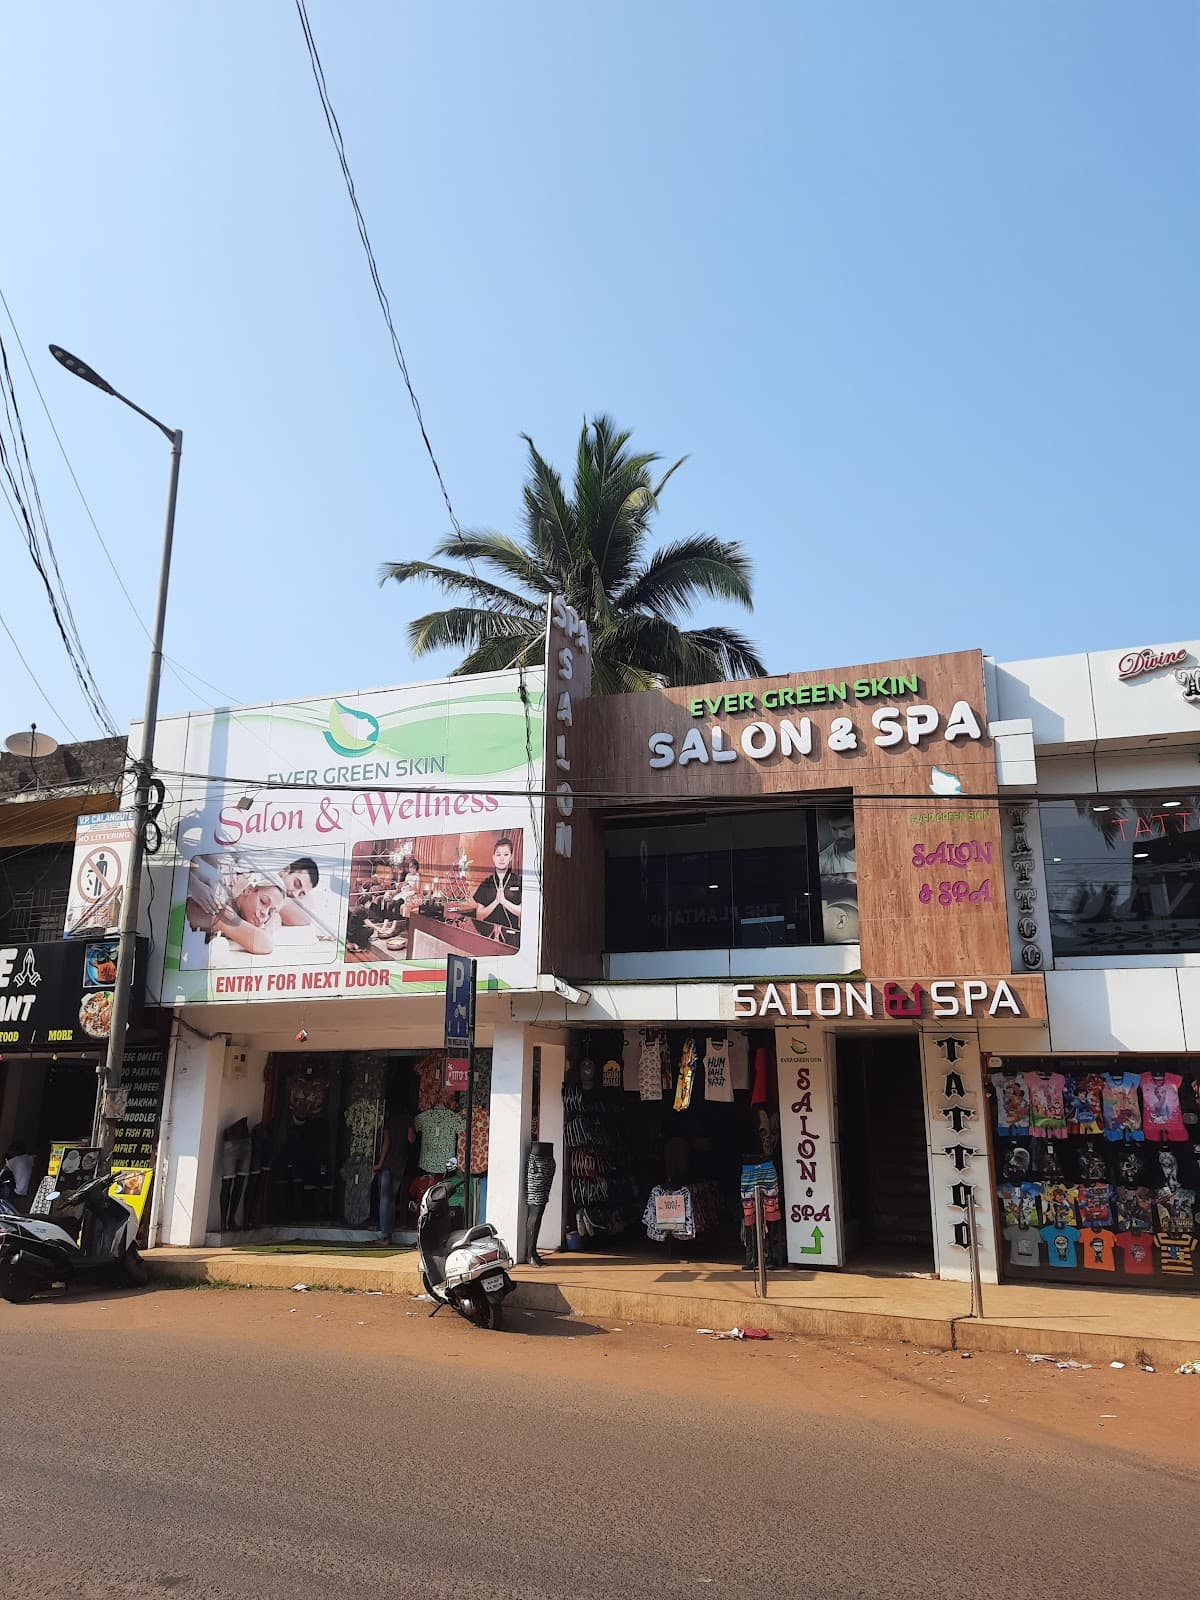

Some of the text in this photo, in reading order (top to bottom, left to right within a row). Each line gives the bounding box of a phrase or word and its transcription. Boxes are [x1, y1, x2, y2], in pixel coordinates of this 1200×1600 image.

[1118, 648, 1188, 680] Divine
[690, 674, 919, 717] EVER GREEN SKIN
[648, 700, 982, 769] SALON & SPA
[555, 647, 574, 859] SALON
[267, 755, 446, 787] EVER GREEN SKIN
[213, 786, 500, 846] Salon & Wellness
[911, 810, 991, 824] EVER GREEN SKIN
[1112, 812, 1200, 841] TATT
[91, 831, 130, 841] LITTERING
[912, 840, 993, 868] SALON
[919, 878, 992, 907] & SPA
[1007, 807, 1044, 970] TATTOO
[215, 969, 390, 993] ENTRY FOR NEXT DOOR
[452, 960, 465, 1002] P
[734, 982, 873, 1017] SALON
[931, 979, 1021, 1016] SPA
[48, 1030, 73, 1041] MORE
[125, 1113, 156, 1122] NOODLES
[791, 1068, 820, 1183] SALON
[125, 1128, 141, 1138] FISH
[934, 1036, 984, 1250] TATTOO
[805, 1187, 814, 1198] &
[790, 1204, 831, 1223] SPA
